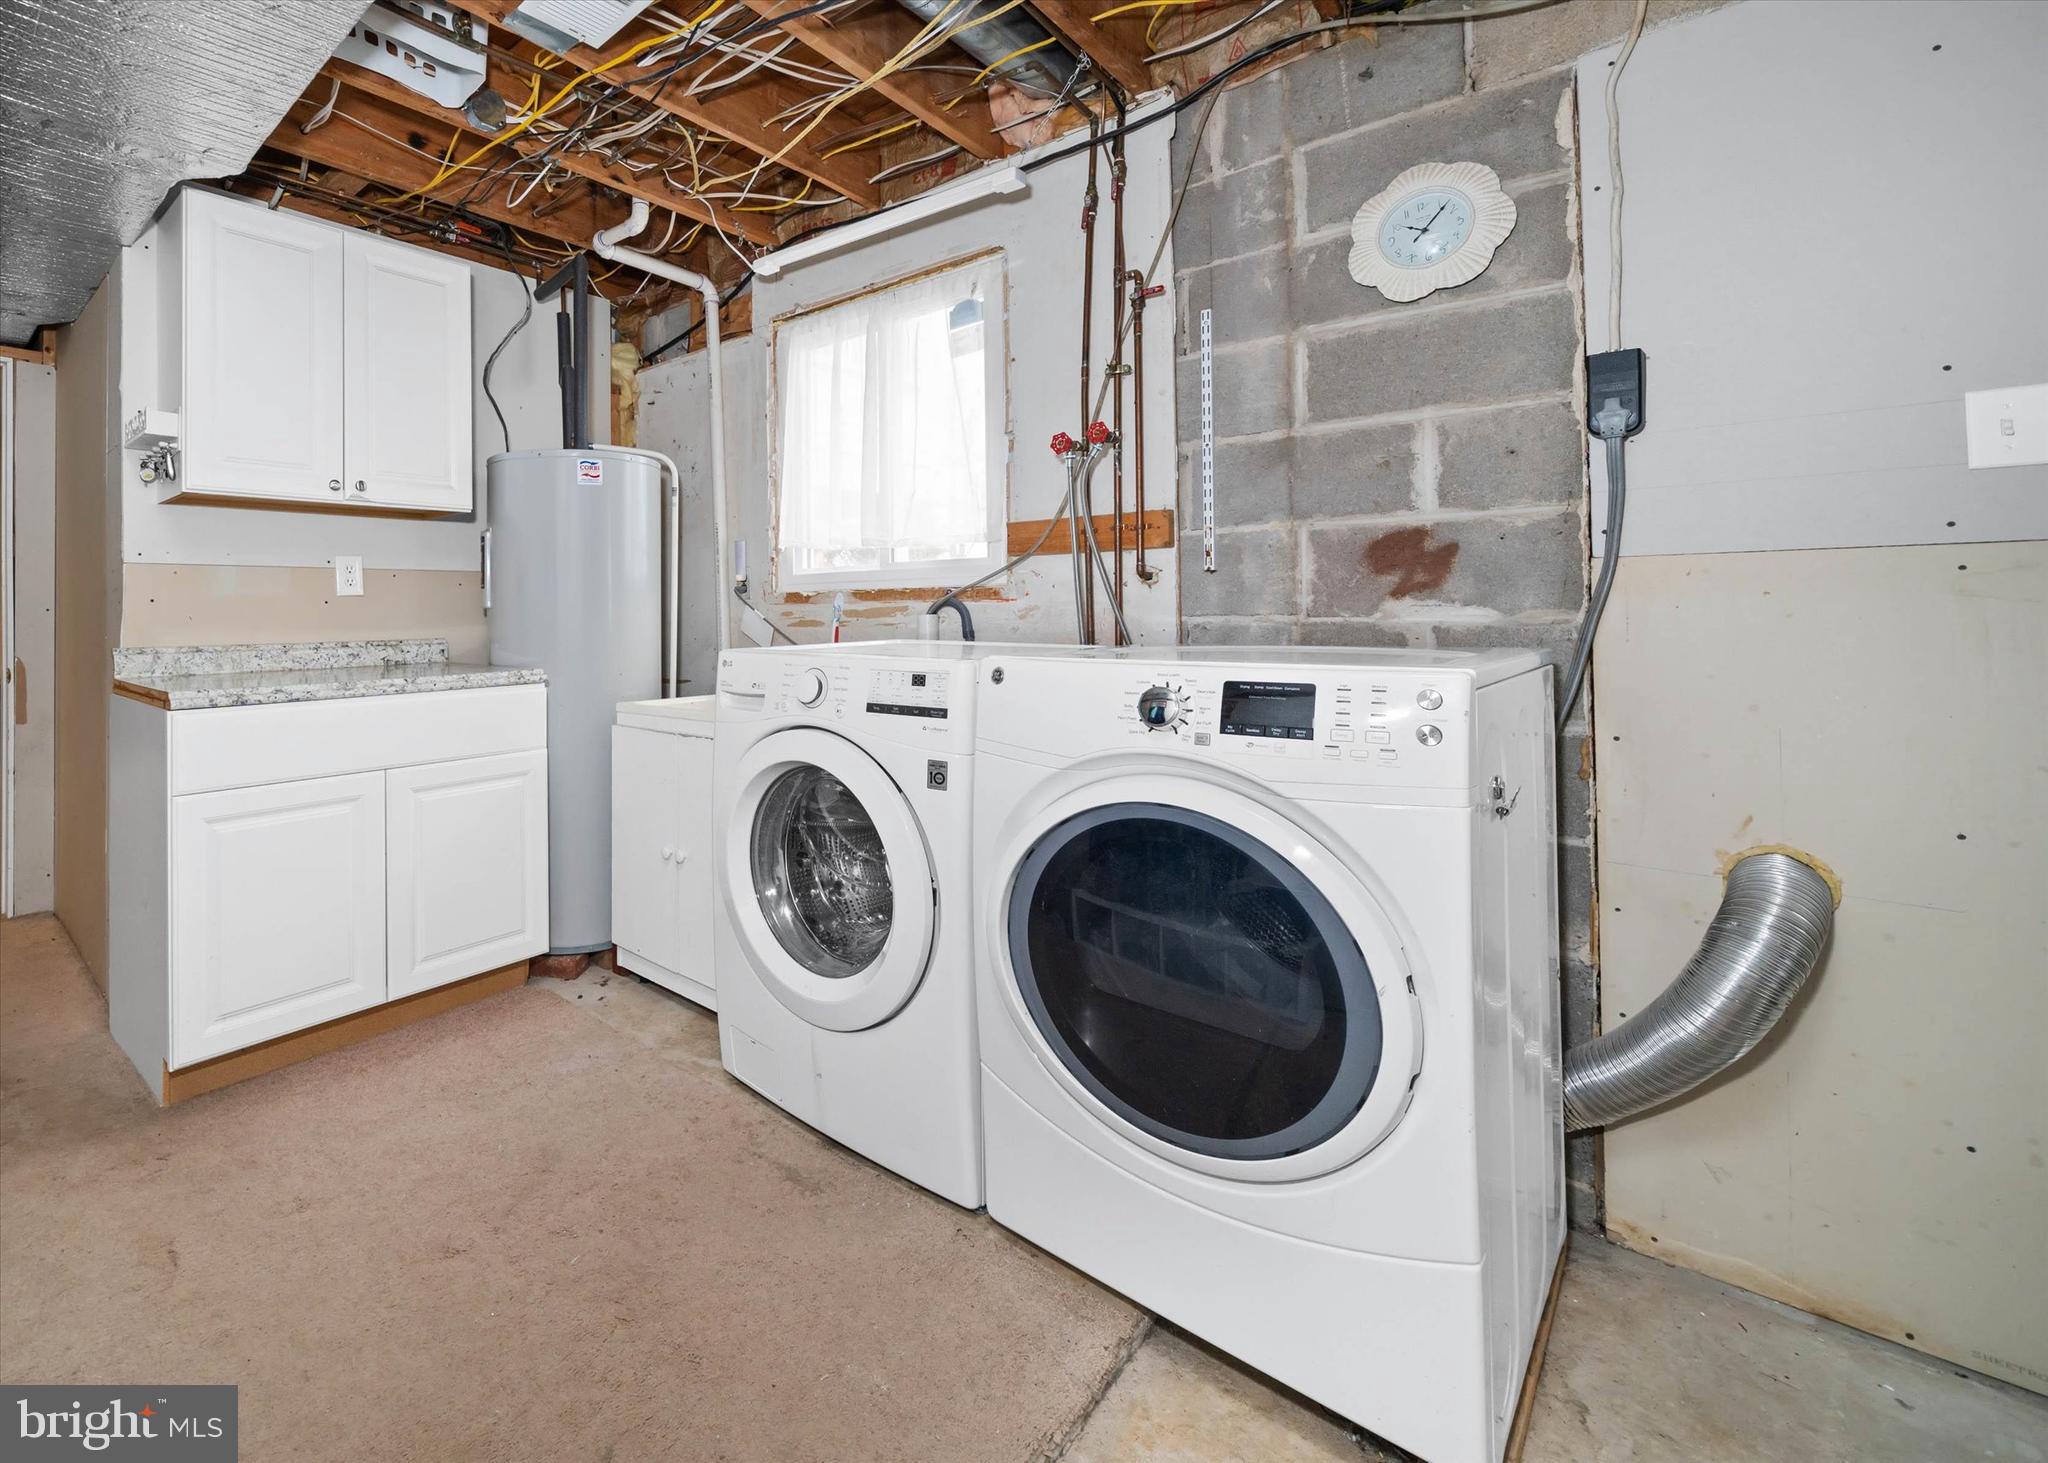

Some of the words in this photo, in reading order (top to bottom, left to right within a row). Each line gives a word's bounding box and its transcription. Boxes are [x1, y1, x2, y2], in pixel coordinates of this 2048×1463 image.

[1417, 202, 1429, 212] 12
[1449, 203, 1458, 214] 2
[1403, 209, 1410, 219] 11
[1457, 216, 1465, 226] 3
[1452, 231, 1460, 240] 4
[1388, 236, 1396, 247] 9
[1440, 241, 1449, 254] 5
[1394, 248, 1402, 258] 8
[1407, 253, 1417, 263] 7
[1425, 251, 1433, 262] 6
